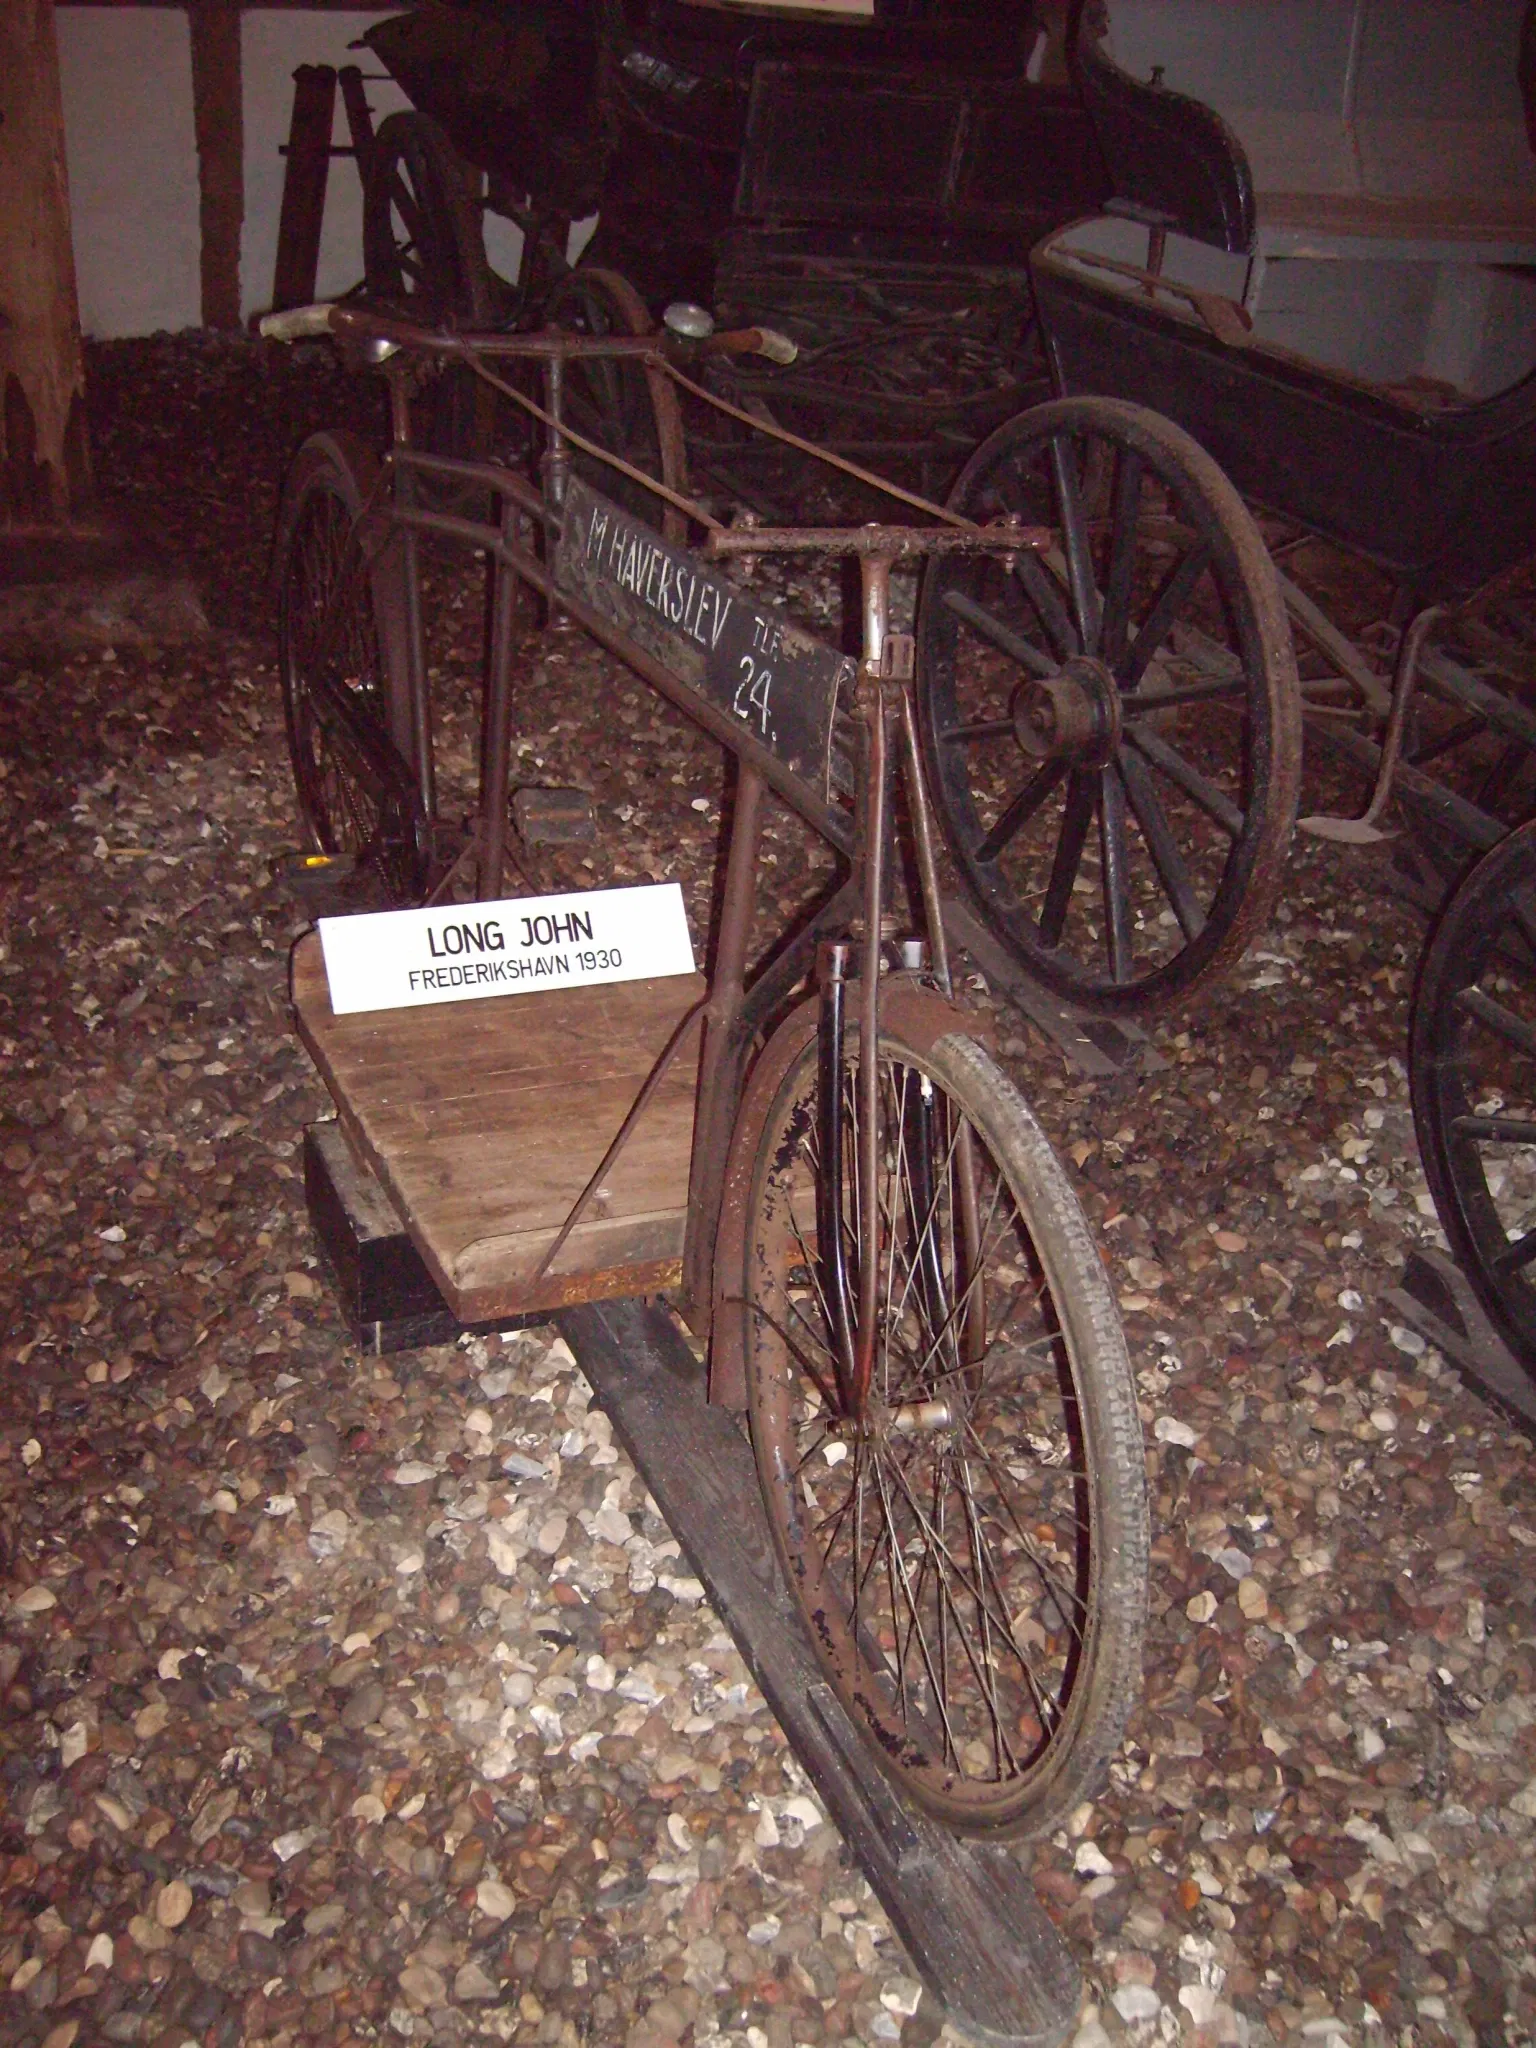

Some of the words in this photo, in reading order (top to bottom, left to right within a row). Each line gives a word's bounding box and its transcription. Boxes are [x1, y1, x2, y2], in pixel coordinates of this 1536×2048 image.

[587, 507, 608, 560] M
[609, 524, 732, 651] HAVERSLEV
[427, 921, 505, 957] LONG
[520, 911, 593, 947] JOHN
[408, 954, 570, 990] FREDERIKSHAVN
[575, 948, 622, 971] 1930
